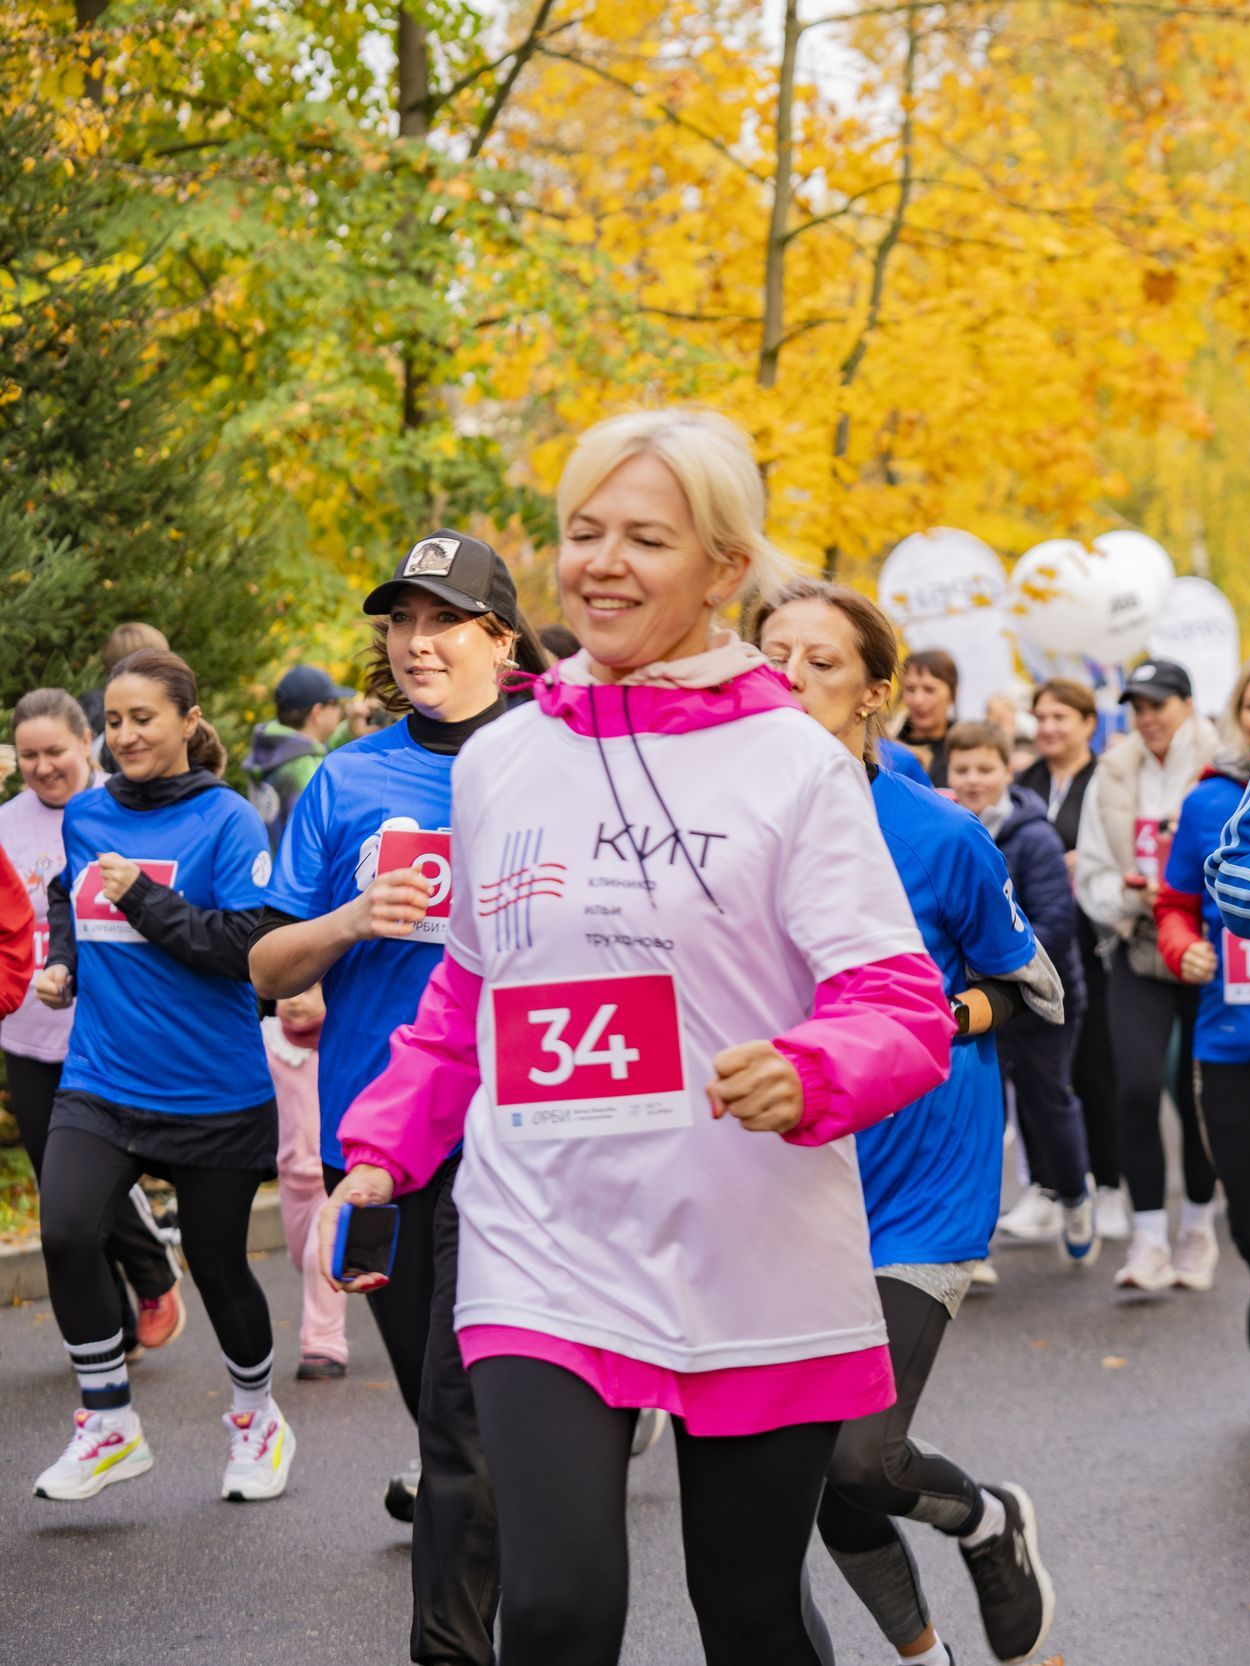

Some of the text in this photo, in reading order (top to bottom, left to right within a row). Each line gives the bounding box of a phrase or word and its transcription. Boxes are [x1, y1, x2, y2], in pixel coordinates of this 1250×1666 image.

[592, 822, 728, 868] КИТ
[411, 853, 453, 907] 9
[528, 1003, 640, 1086] 34
